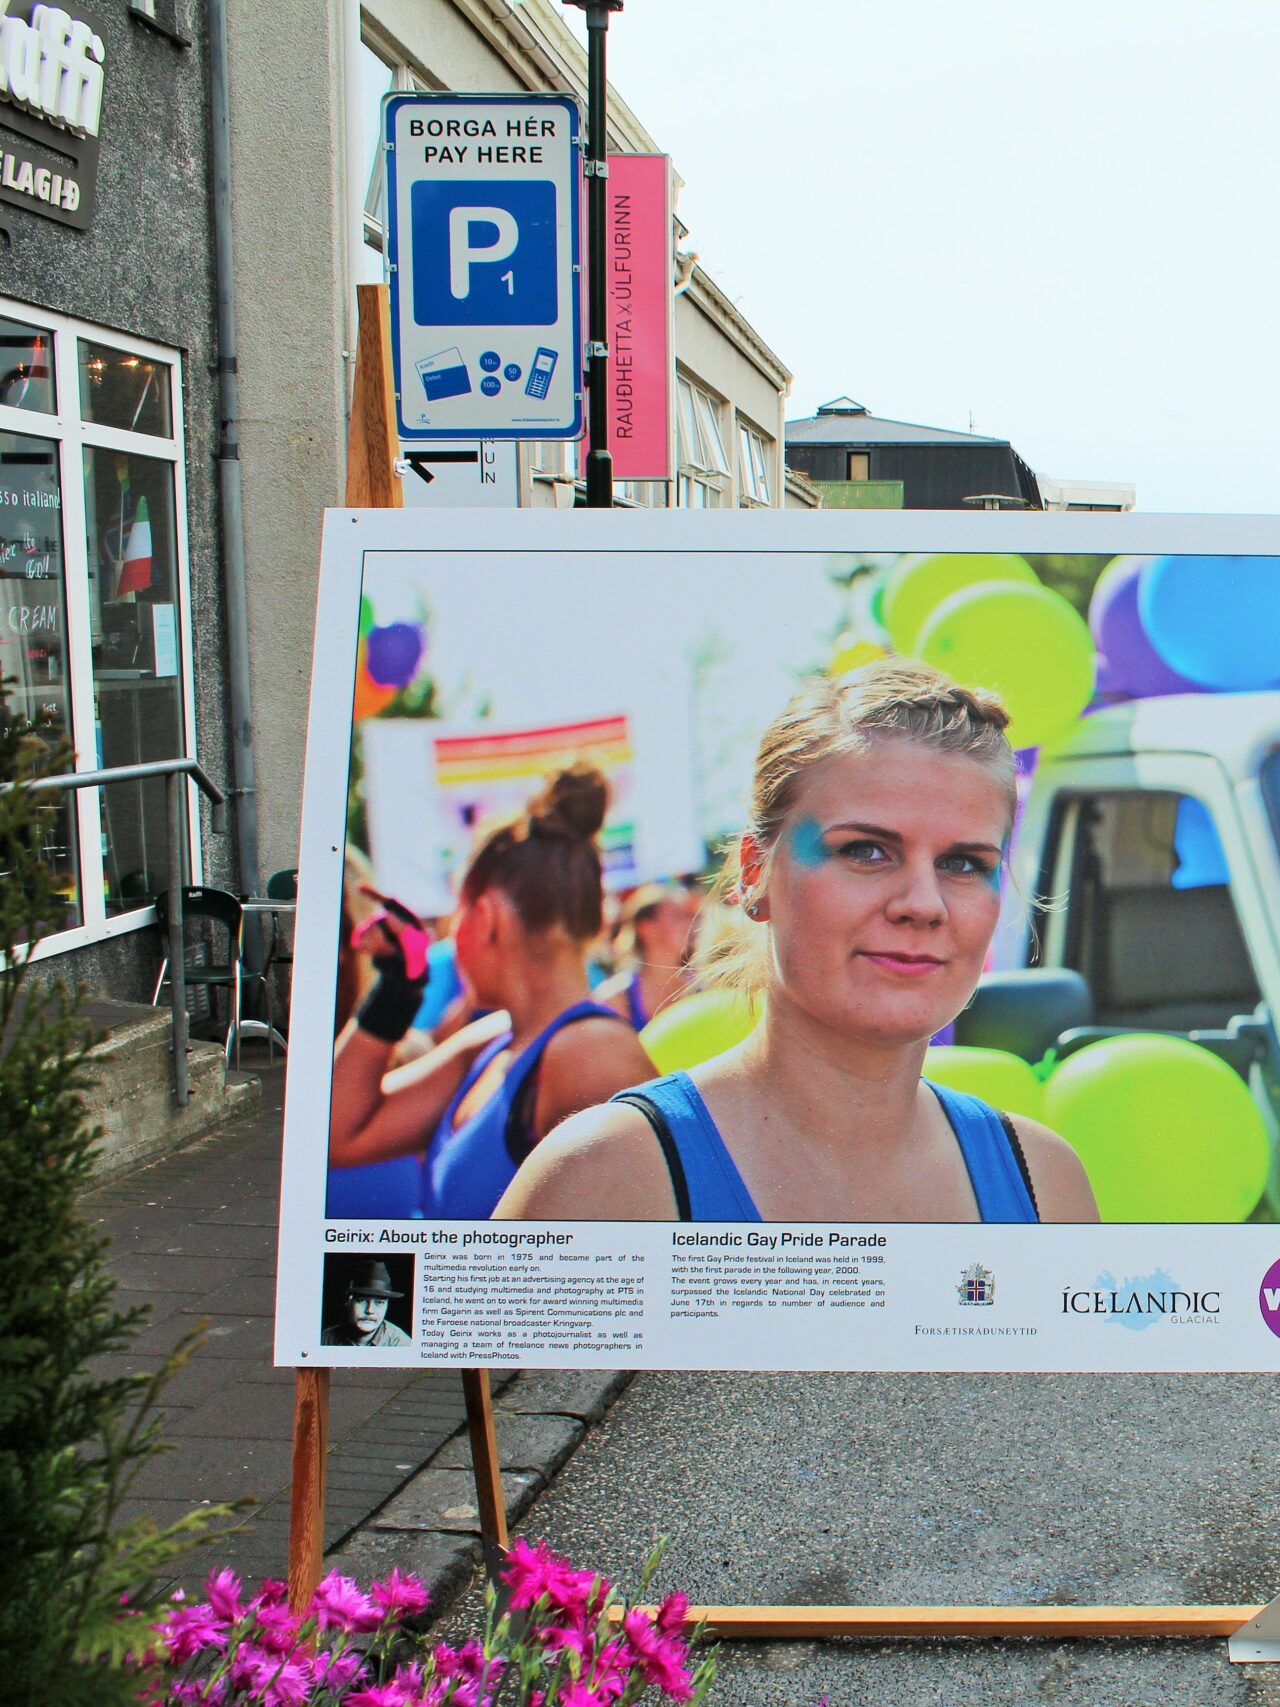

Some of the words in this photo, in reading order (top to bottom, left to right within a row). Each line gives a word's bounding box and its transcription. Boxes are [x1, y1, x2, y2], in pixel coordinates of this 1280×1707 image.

[0, 3, 105, 137] affi
[410, 120, 497, 137] BORGA
[507, 116, 556, 137] HÉR
[425, 147, 467, 163] PAY
[478, 147, 543, 163] HERE
[0, 152, 80, 211] LAGIÐ
[611, 194, 633, 300] ÚLFURINN
[450, 207, 519, 299] P
[501, 270, 514, 295] 1
[616, 319, 633, 439] RAUÐHETTA
[9, 605, 57, 632] CREAM
[325, 1228, 374, 1243] Geirix:
[379, 1230, 427, 1244] About
[432, 1230, 458, 1244] the
[463, 1231, 573, 1247] photographer
[672, 1232, 742, 1246] Icelandic
[747, 1232, 777, 1250] Gay
[781, 1232, 823, 1246] Pride
[829, 1233, 887, 1246] Parade
[497, 1253, 505, 1261] in
[512, 1253, 533, 1261] 1975
[539, 1253, 553, 1261] and
[595, 1255, 612, 1263] part
[706, 1255, 722, 1264] Gay
[723, 1255, 744, 1263] Pride
[746, 1255, 775, 1263] festival
[776, 1255, 784, 1263] in
[785, 1255, 813, 1263] Iceland
[509, 1264, 528, 1273] early
[671, 1265, 688, 1273] with
[690, 1265, 703, 1273] the
[724, 1266, 752, 1275] parade
[778, 1266, 813, 1275] following
[814, 1268, 834, 1276] year,
[423, 1275, 456, 1284] Starting
[488, 1275, 500, 1284] job
[522, 1275, 565, 1285] advertising
[567, 1277, 595, 1285] agency
[620, 1277, 635, 1285] age
[672, 1276, 685, 1284] The
[713, 1278, 738, 1286] grows
[740, 1278, 762, 1286] every
[785, 1277, 800, 1285] and
[822, 1277, 829, 1285] in
[423, 1285, 434, 1293] 16
[437, 1285, 452, 1293] and
[455, 1286, 488, 1295] studying
[537, 1286, 551, 1294] and
[554, 1286, 603, 1296] photography
[671, 1288, 712, 1297] surpassed
[809, 1288, 825, 1297] Day
[829, 1288, 871, 1296] celebrated
[422, 1296, 452, 1305] Iceland,
[529, 1297, 541, 1305] for
[542, 1297, 567, 1305] award
[569, 1298, 598, 1307] winning
[732, 1299, 763, 1308] regards
[782, 1299, 813, 1307] number
[817, 1299, 826, 1307] of
[830, 1299, 866, 1307] audience
[870, 1299, 885, 1307] and
[441, 1308, 471, 1317] Gagarin
[515, 1308, 545, 1317] Spirent
[614, 1309, 626, 1318] plc
[1170, 1316, 1220, 1324] GLACIAL
[422, 1329, 444, 1339] Today
[532, 1330, 592, 1340] photojournalist
[421, 1340, 459, 1350] managing
[508, 1341, 545, 1349] freelance
[573, 1342, 632, 1351] photographers
